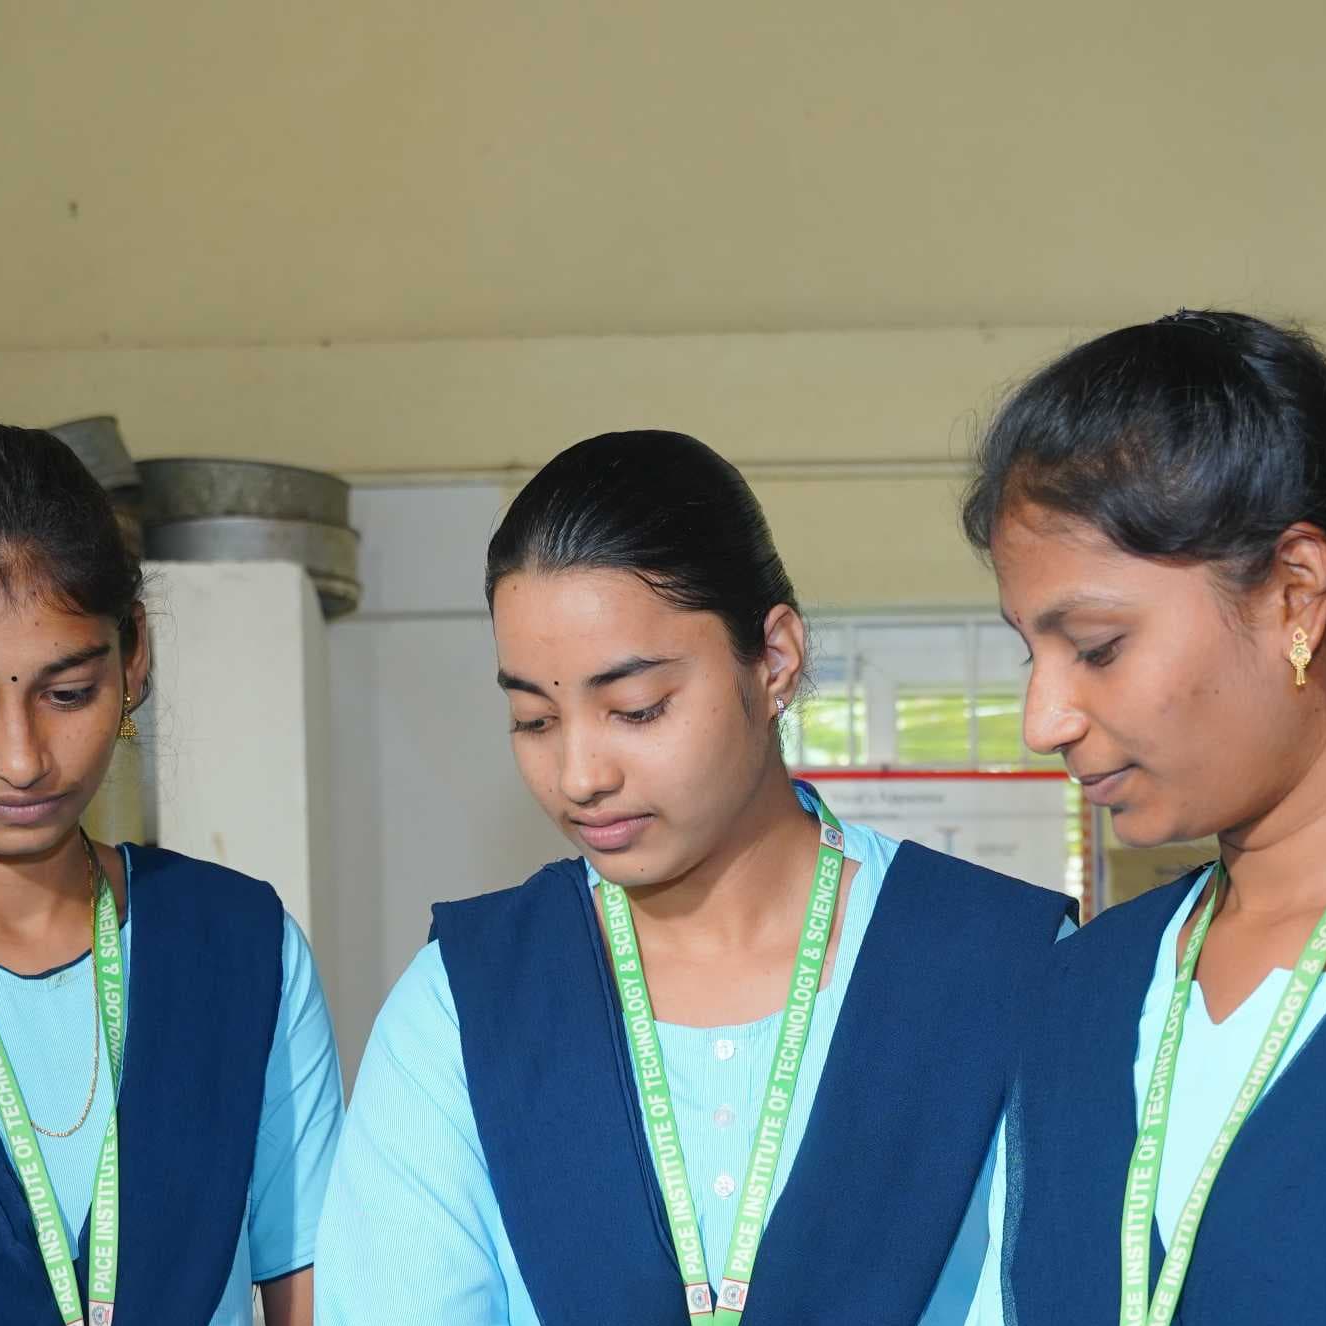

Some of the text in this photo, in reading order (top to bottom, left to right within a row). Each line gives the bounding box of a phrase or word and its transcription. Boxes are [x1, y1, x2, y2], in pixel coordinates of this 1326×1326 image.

[101, 963, 120, 975] &
[103, 980, 121, 1077] HNOLOGY
[602, 879, 703, 1276] PACE INSTITUTE OF TECHNOLOGY & SCIENCE
[731, 855, 839, 1273] PACE INSTITUTE OF TECHNOLOGY & SCIENCES
[1144, 991, 1185, 1127] TECHNOLOGY
[11, 1132, 33, 1159] OF
[1138, 1134, 1158, 1161] OF
[1165, 1166, 1214, 1287] INSTITUTE
[1211, 1133, 1230, 1160] OF
[1228, 977, 1309, 1127] TECHNOLOGY
[1302, 958, 1321, 975] &
[20, 1161, 63, 1265] INSTITUTE
[95, 1141, 115, 1241] INSTITUTE
[1126, 1166, 1153, 1286] INSTITUTE
[50, 1264, 75, 1315] PACE
[93, 1246, 113, 1294] PACE
